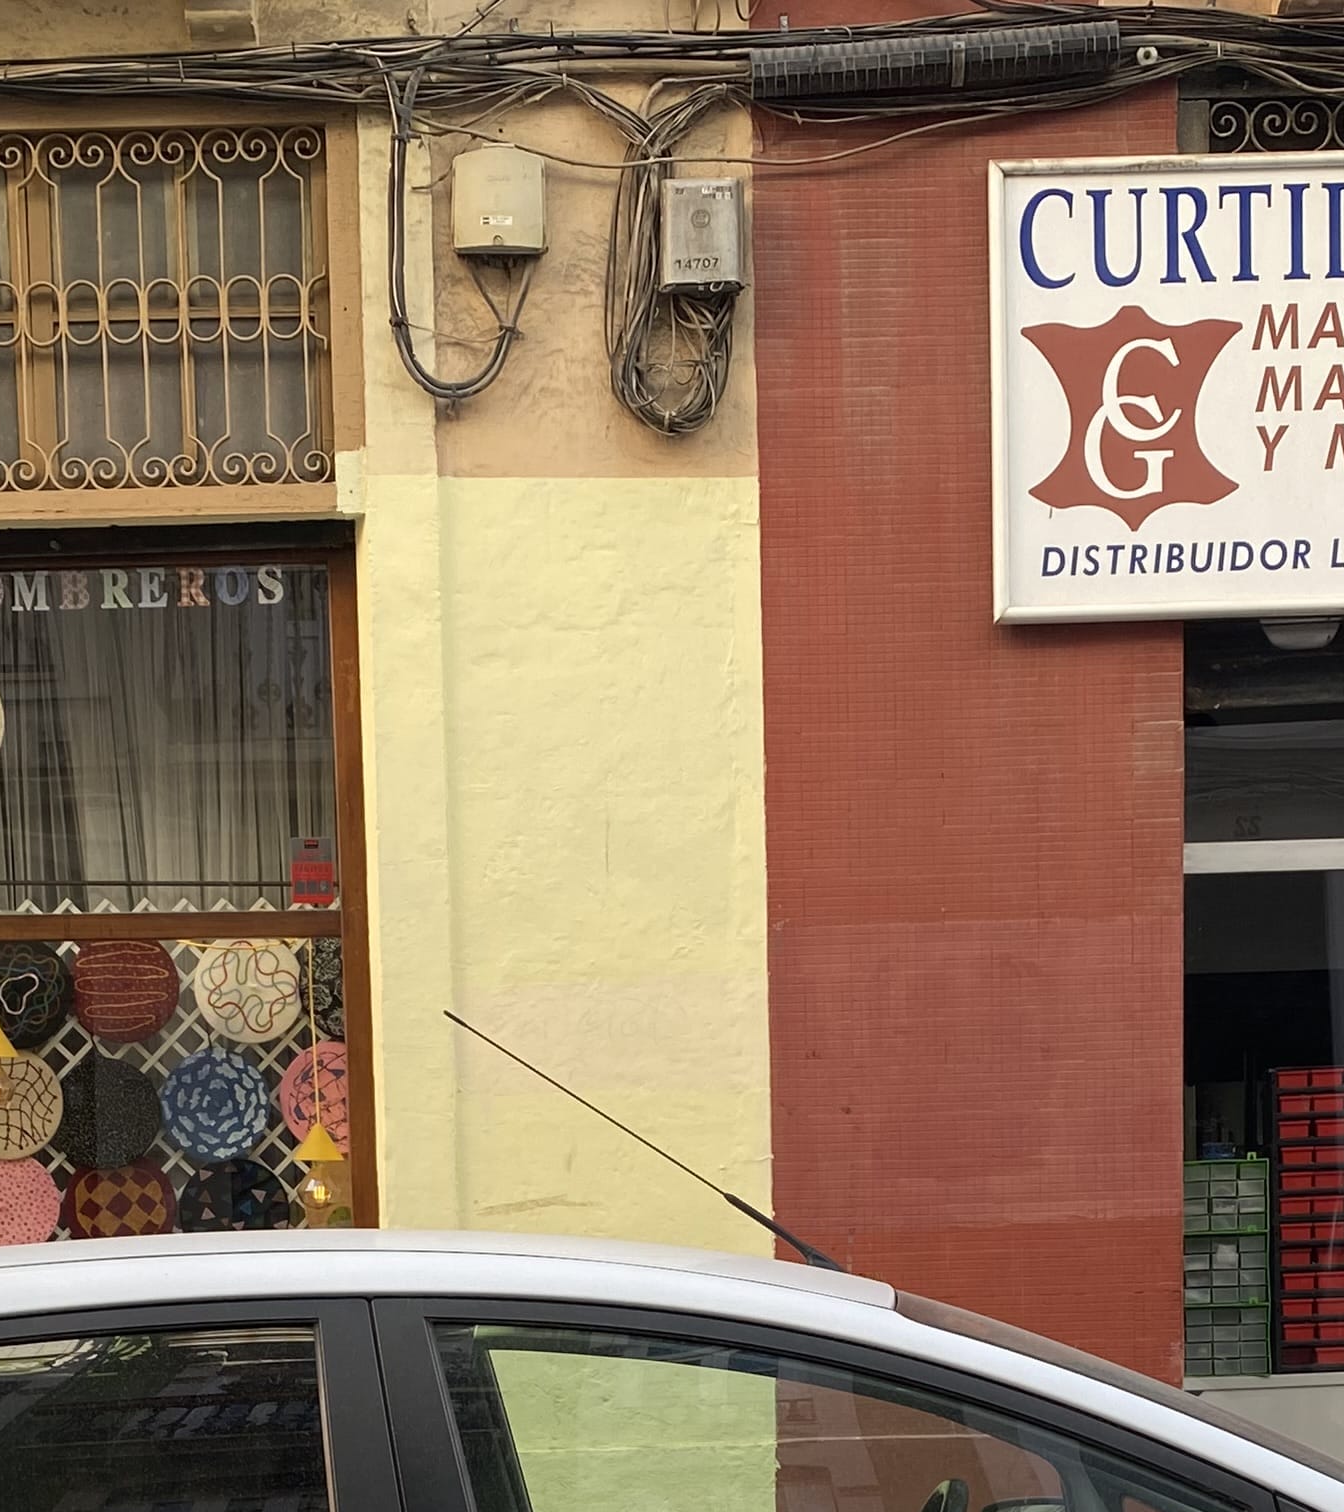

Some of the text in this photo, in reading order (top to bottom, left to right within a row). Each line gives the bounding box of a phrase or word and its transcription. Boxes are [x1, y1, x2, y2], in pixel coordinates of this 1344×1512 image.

[674, 257, 719, 270] 14707
[1256, 424, 1290, 472] Y
[1041, 539, 1311, 577] DISTRIBUIDOR
